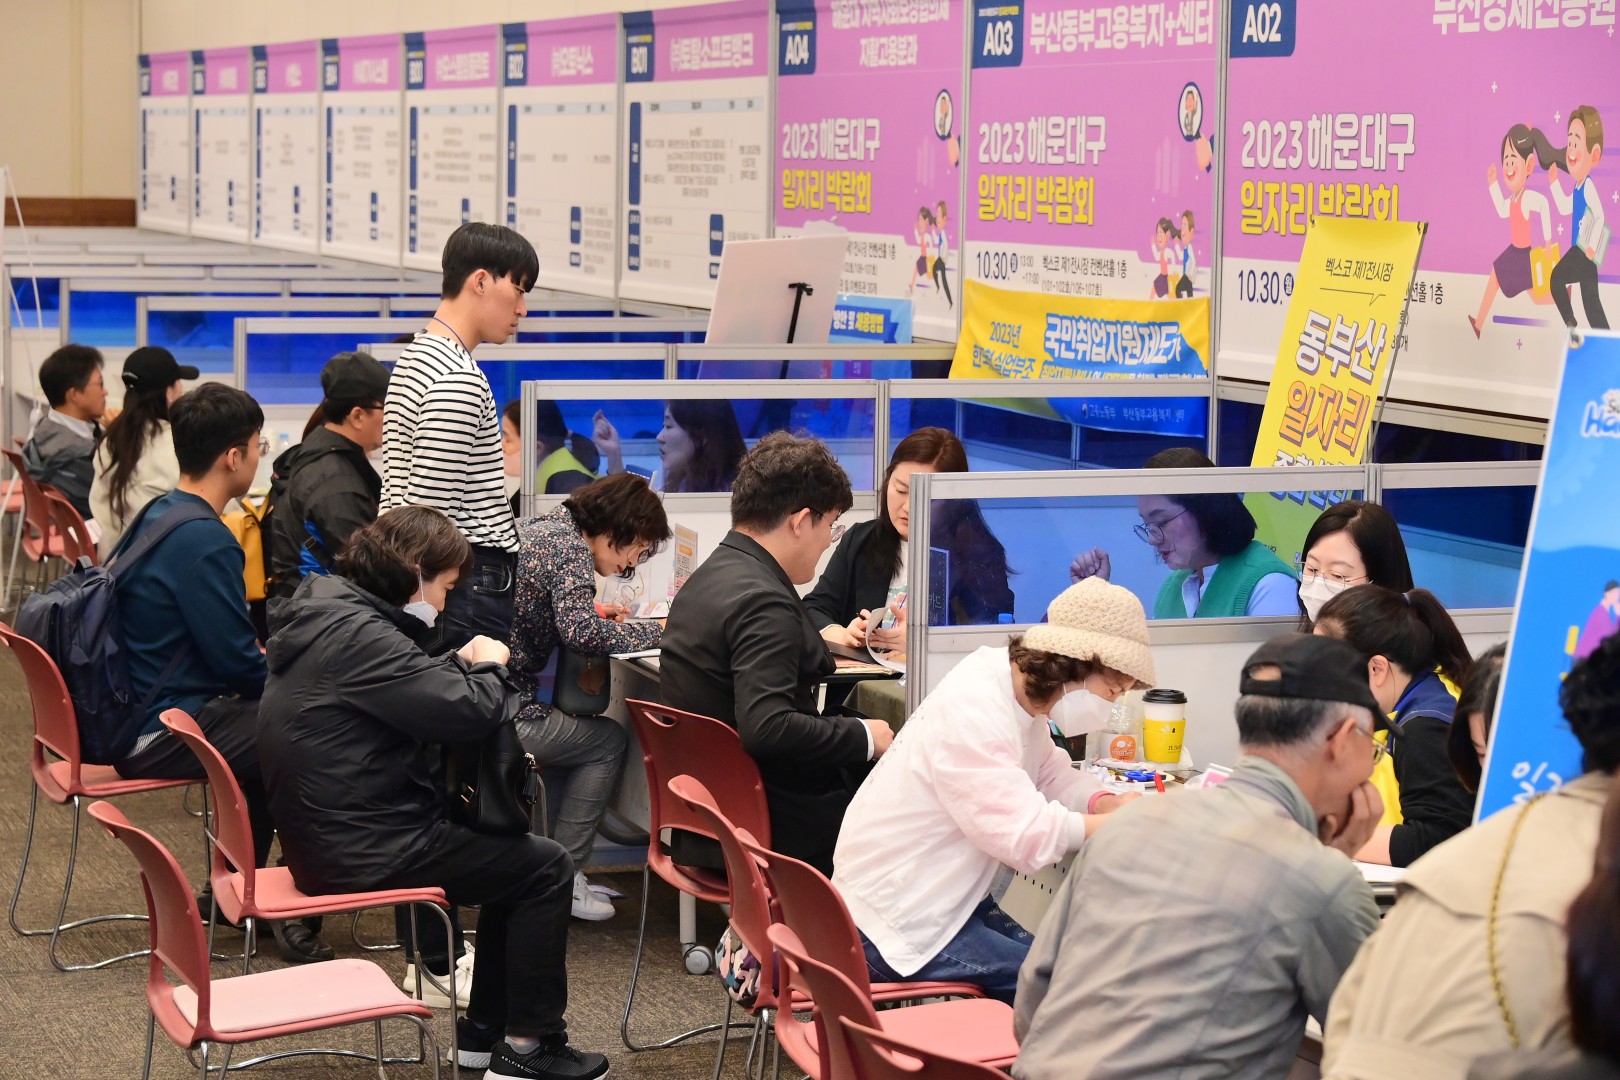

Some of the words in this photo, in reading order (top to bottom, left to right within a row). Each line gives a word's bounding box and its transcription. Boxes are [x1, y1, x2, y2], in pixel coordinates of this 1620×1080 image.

[983, 20, 1014, 56] A03
[1029, 1, 1214, 54] 부산동부고용복지+센터
[1242, 2, 1282, 43] A02
[784, 34, 810, 66] A04
[782, 122, 818, 160] 2023
[820, 118, 881, 162] 해운대구
[978, 121, 1025, 164] 2023
[1027, 115, 1107, 166] 해운대구
[1241, 119, 1304, 170] 2023
[1307, 112, 1416, 172] 해운대구
[783, 168, 824, 211] 일자리
[826, 169, 872, 215] 박람회
[978, 173, 1033, 223] 일자리
[1036, 175, 1095, 226] 박람회
[1240, 179, 1315, 236] 일자리
[1325, 257, 1353, 278] 벡스코
[1353, 261, 1394, 283] 제1전시장
[1430, 283, 1444, 305] 1층
[989, 321, 1022, 349] 2023년
[1295, 309, 1388, 386] 동부산
[1279, 380, 1371, 457] 일자리
